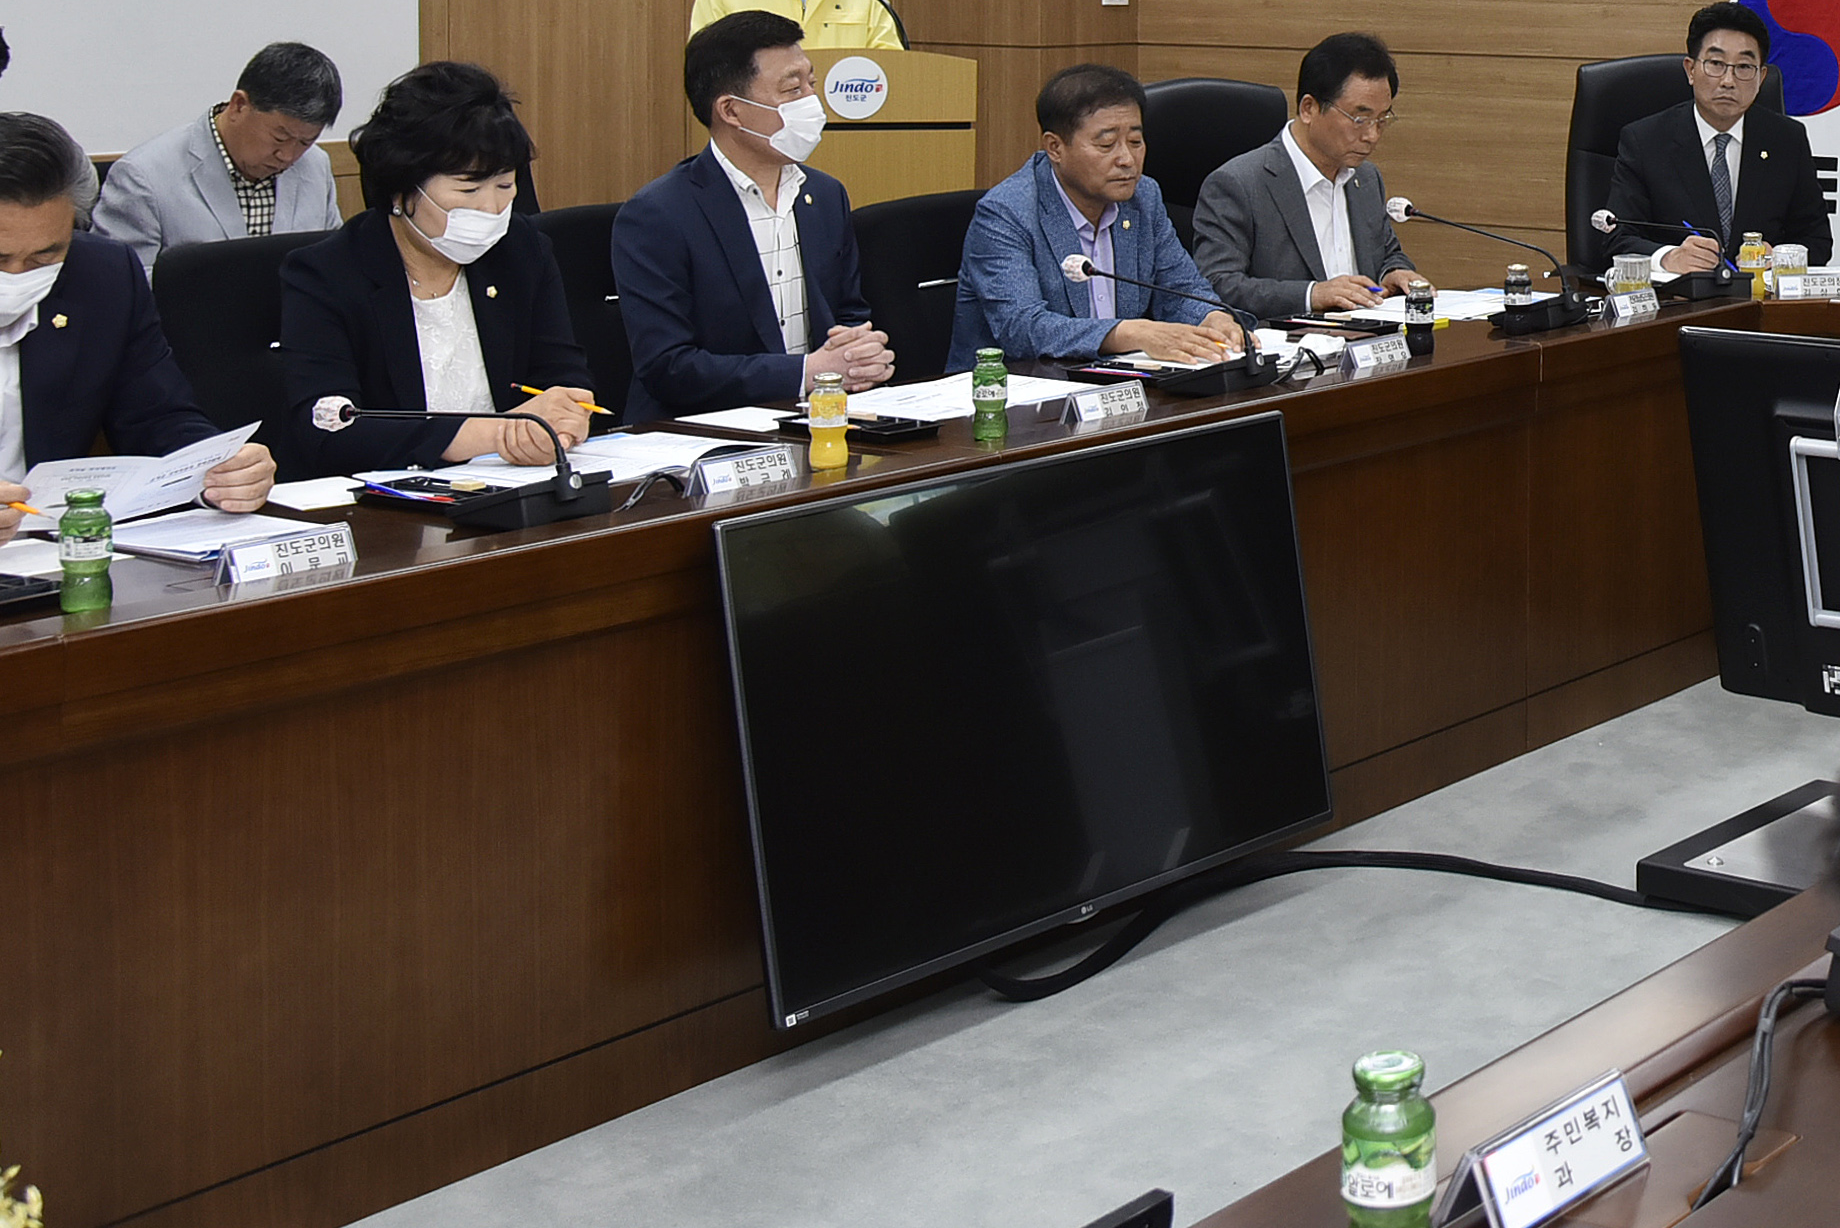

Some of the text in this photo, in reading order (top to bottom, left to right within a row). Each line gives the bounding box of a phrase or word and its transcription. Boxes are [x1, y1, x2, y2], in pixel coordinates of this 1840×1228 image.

[829, 80, 874, 94] Jindo
[734, 452, 788, 473] 진도군의원
[274, 532, 346, 558] 진도군의원
[1544, 1094, 1621, 1155] 주민복지
[1347, 1173, 1394, 1200] 알로에
[1505, 1176, 1535, 1205] Jindo
